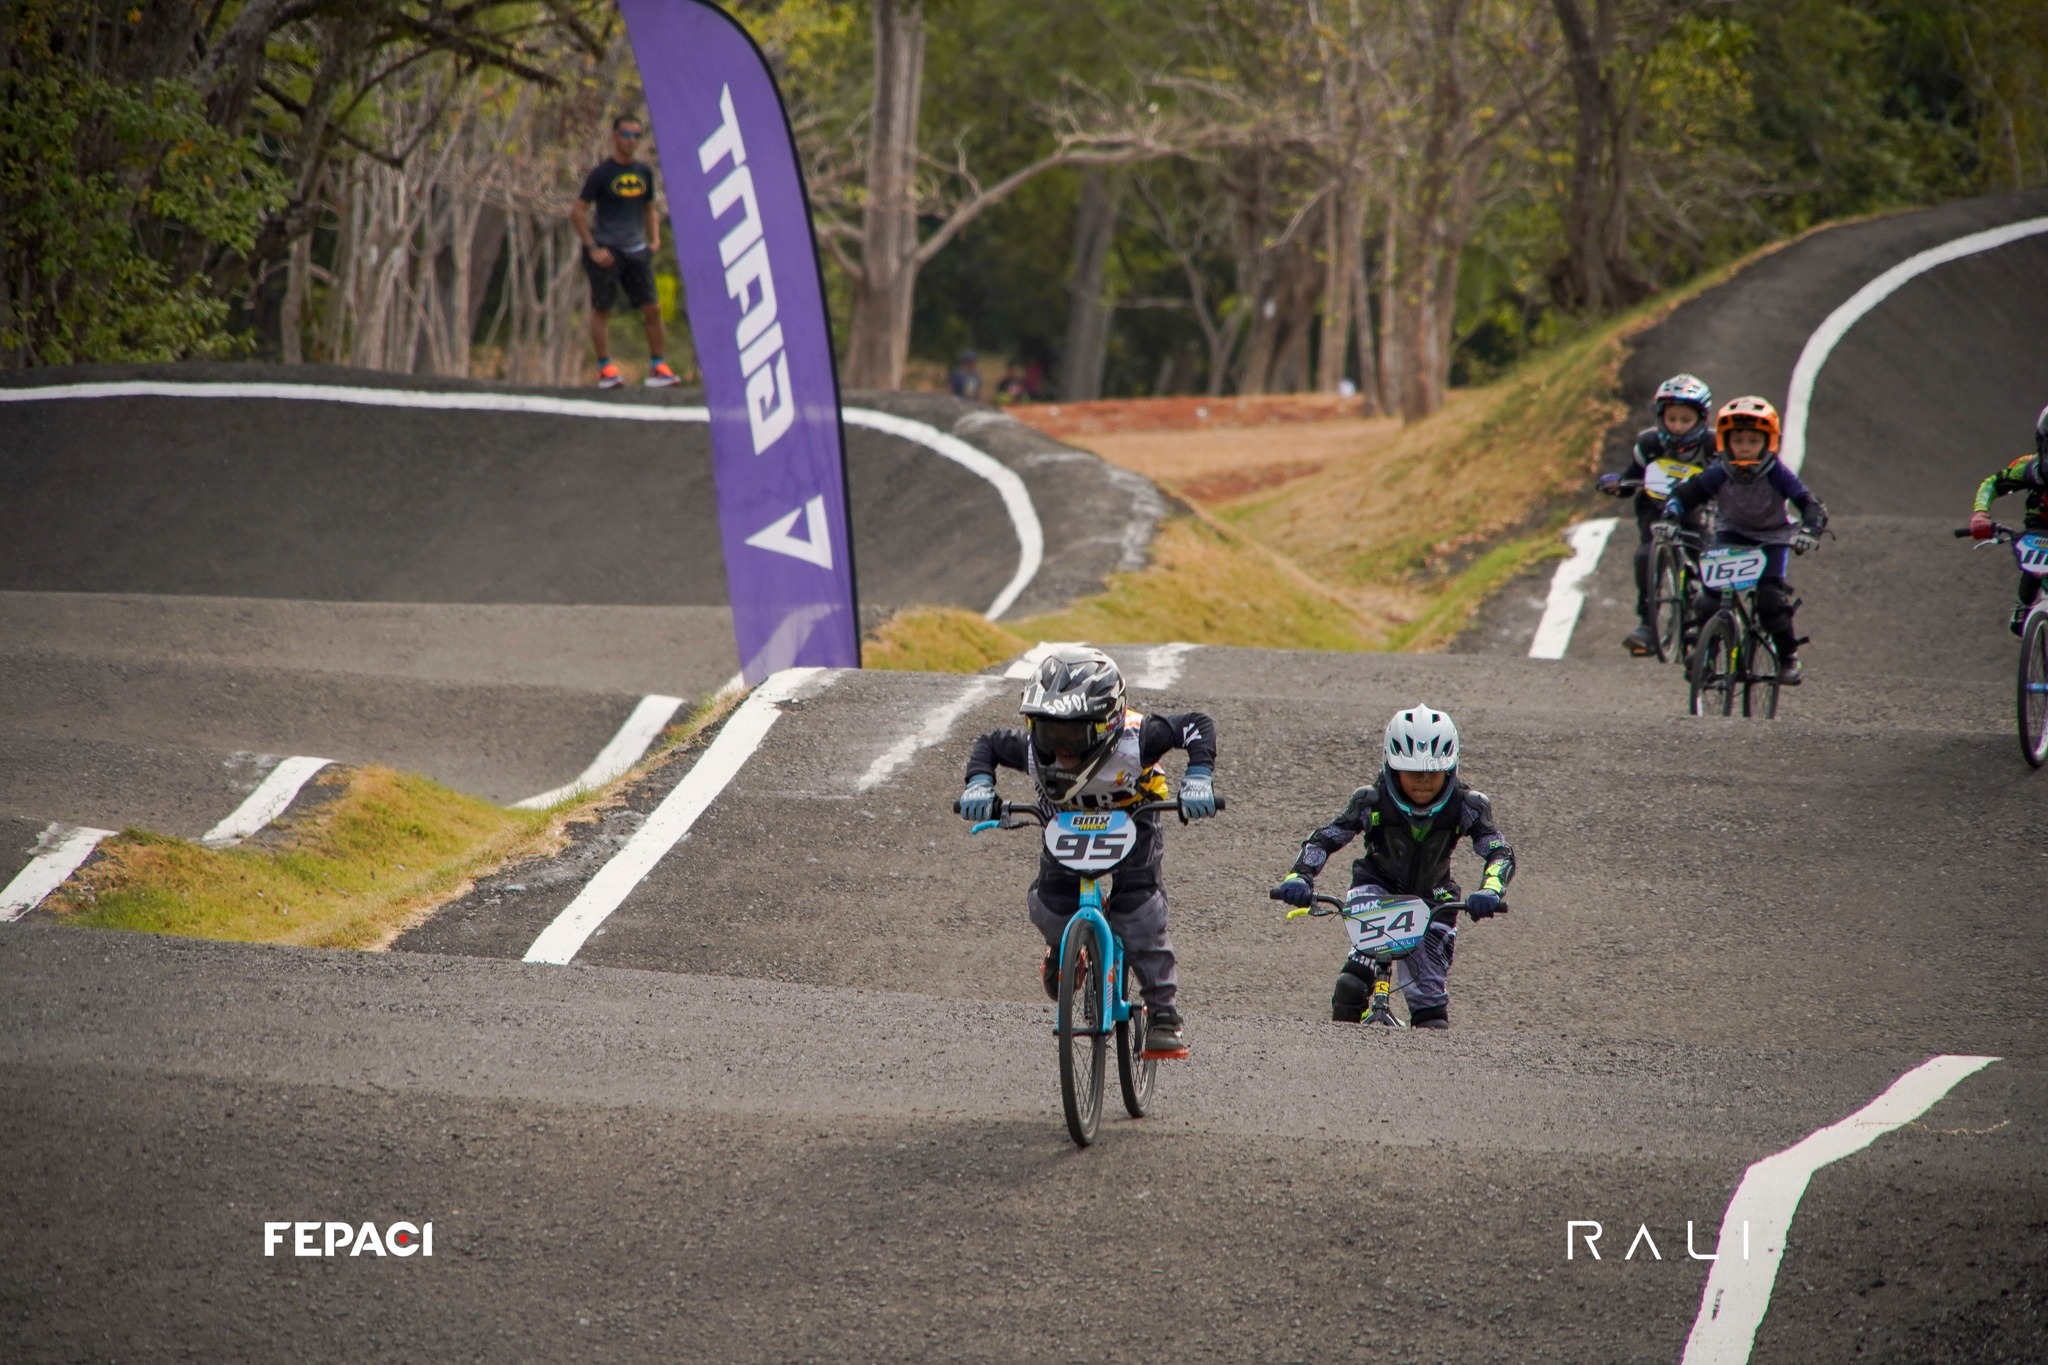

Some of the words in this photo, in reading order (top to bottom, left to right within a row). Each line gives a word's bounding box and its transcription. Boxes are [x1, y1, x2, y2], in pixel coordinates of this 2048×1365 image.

[1705, 558, 1759, 582] 162
[1072, 815, 1111, 826] BMX
[1054, 833, 1128, 860] 95
[1351, 899, 1380, 914] BMX
[1359, 910, 1415, 943] 54
